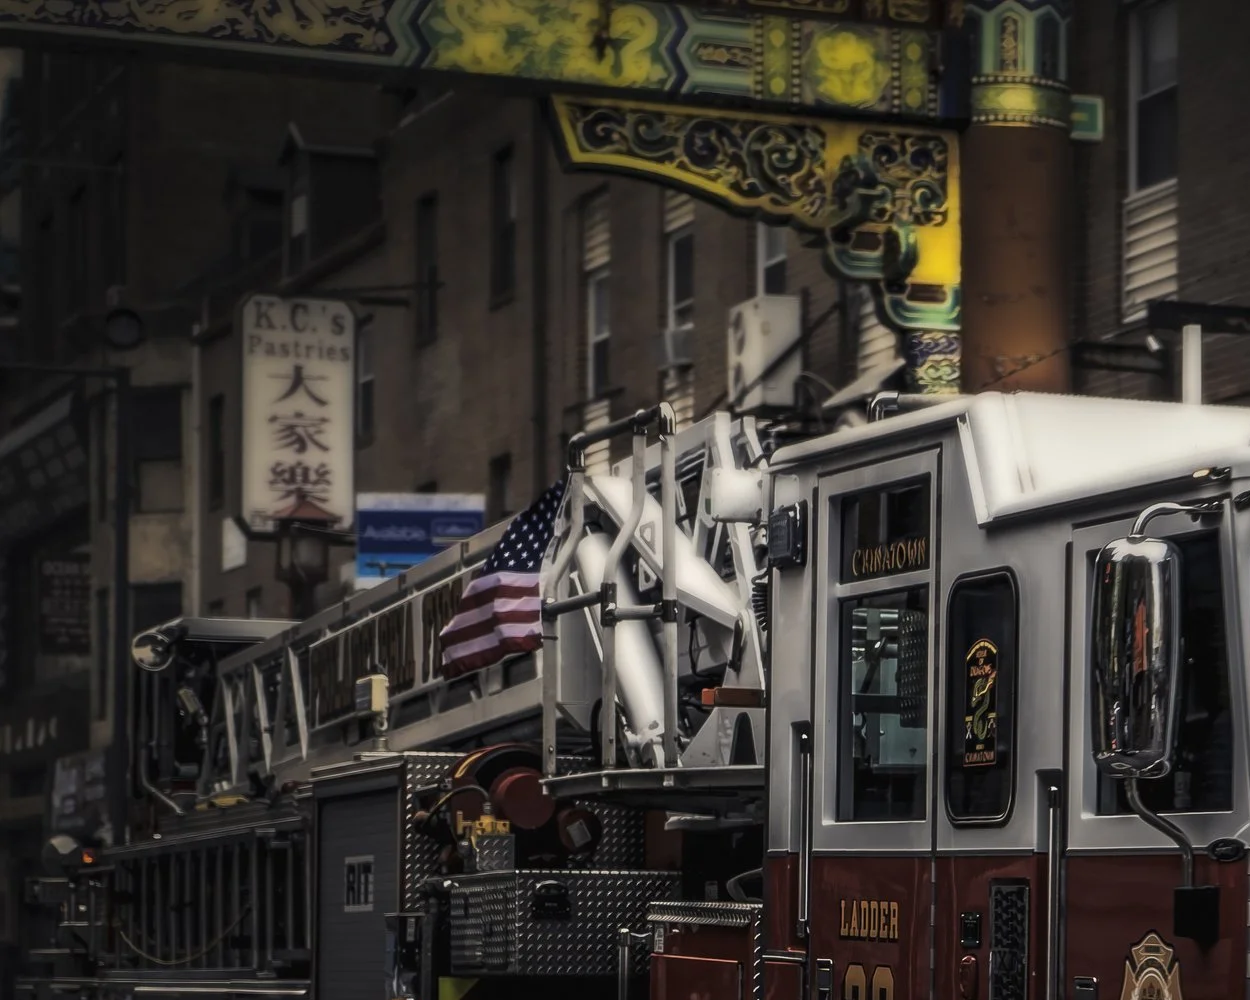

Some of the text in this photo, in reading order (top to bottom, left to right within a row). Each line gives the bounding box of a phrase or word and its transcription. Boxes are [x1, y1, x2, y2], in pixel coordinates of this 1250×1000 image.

[253, 301, 346, 336] K.C.'s
[247, 334, 351, 362] Pastries
[851, 536, 927, 577] CHINATOWN
[838, 898, 900, 942] LADDER
